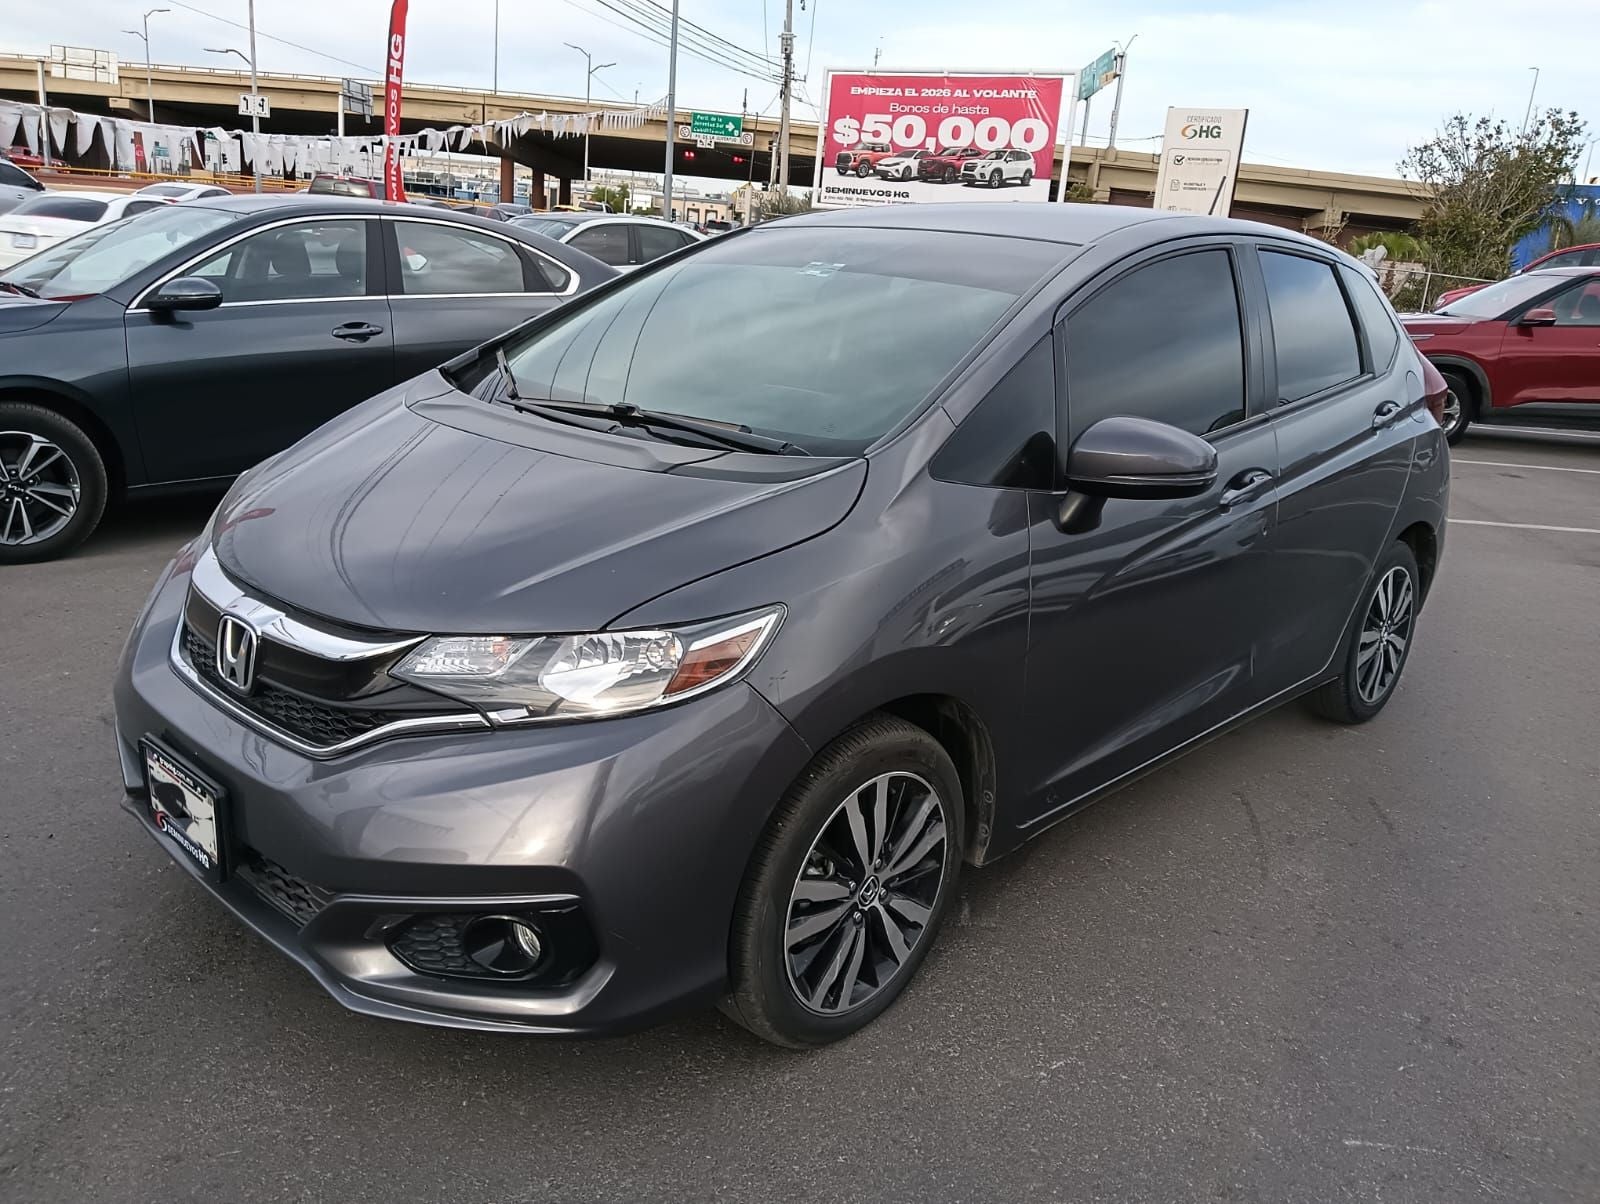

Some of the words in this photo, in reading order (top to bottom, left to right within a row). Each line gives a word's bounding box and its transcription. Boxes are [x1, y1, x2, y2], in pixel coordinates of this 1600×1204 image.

[389, 33, 403, 85] HG
[850, 86, 902, 97] EMPIEZA
[904, 88, 919, 97] EL
[921, 88, 951, 98] 2026
[953, 89, 971, 98] AL
[973, 89, 1038, 99] VOLANTE
[889, 102, 930, 113] Bonos
[932, 103, 949, 114] de
[952, 104, 989, 115] hasta
[832, 113, 1050, 155] $50,000
[1198, 125, 1222, 139] HG
[739, 190, 764, 200] VIERO
[825, 186, 892, 197] SEMINUEVOS
[893, 191, 910, 199] HG
